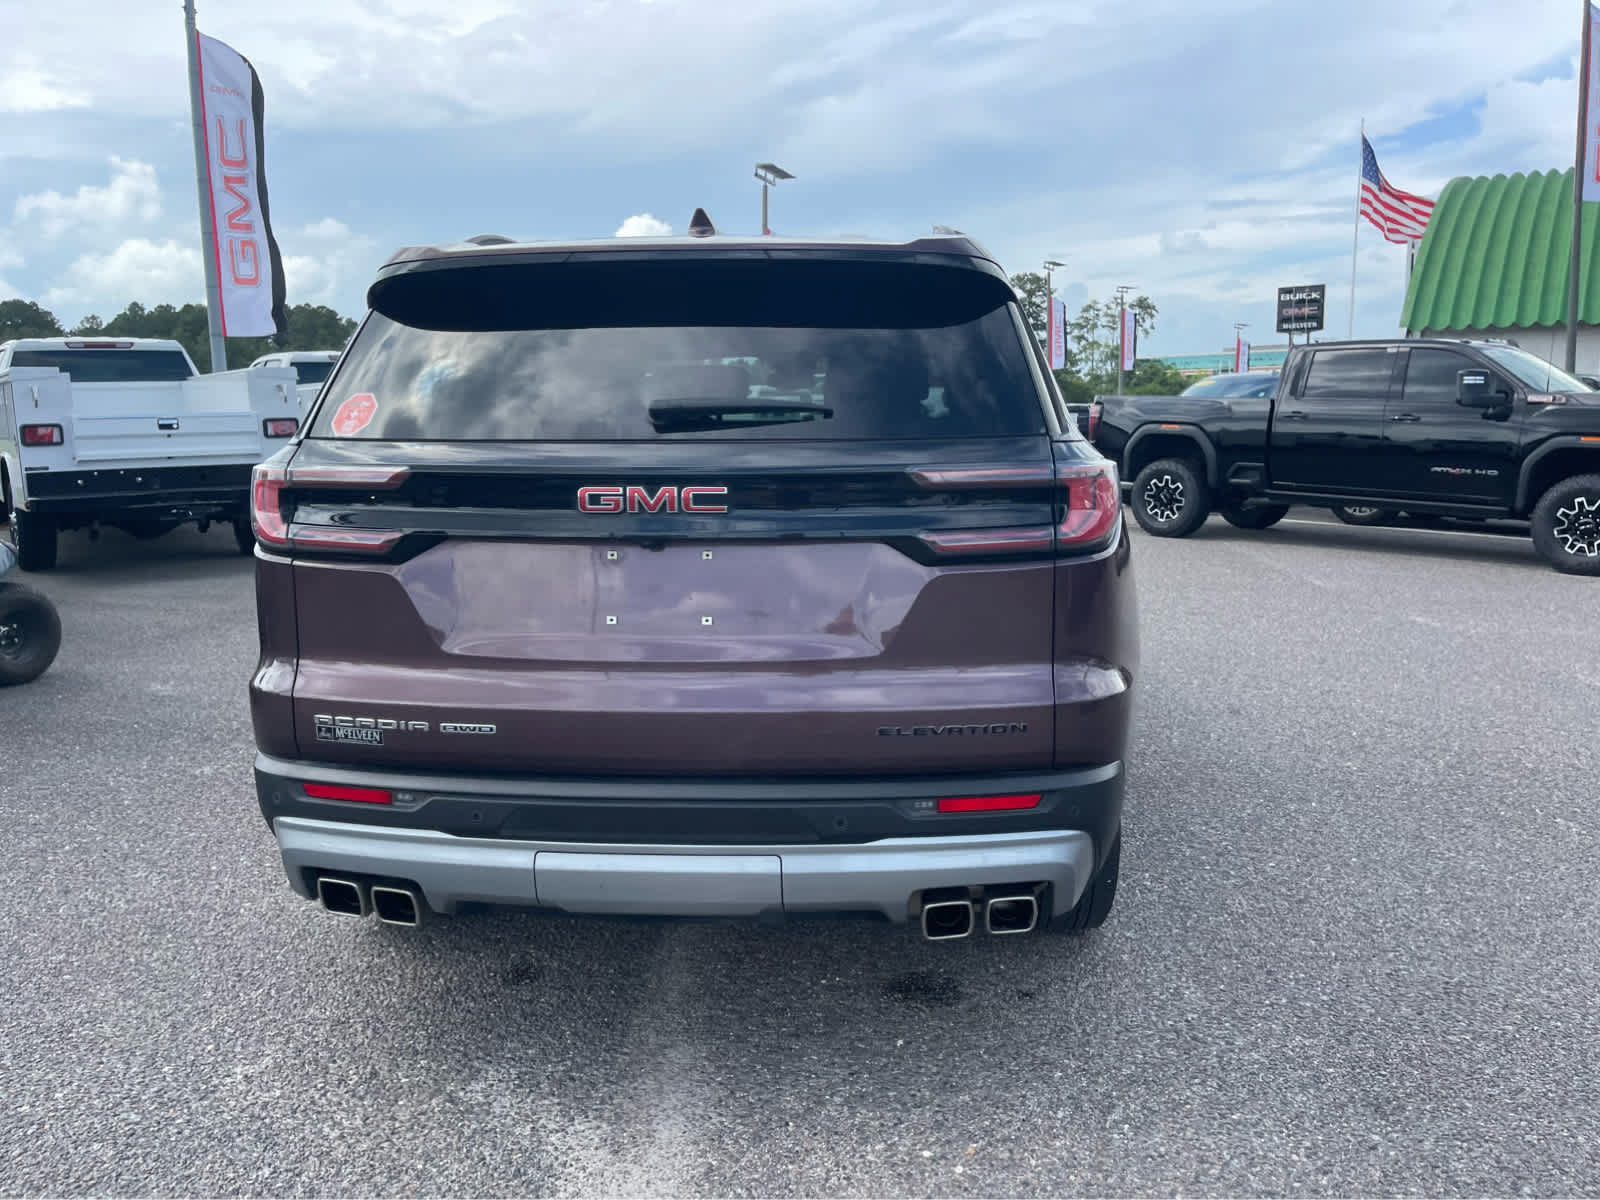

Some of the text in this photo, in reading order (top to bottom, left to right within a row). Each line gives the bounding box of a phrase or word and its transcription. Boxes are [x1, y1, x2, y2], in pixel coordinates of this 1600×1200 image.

[217, 117, 260, 287] GMC
[1280, 292, 1320, 301] BUICK
[1282, 306, 1318, 316] GMC
[577, 486, 729, 514] GMC
[313, 714, 497, 734] ACADIA AWD
[877, 723, 1029, 737] ELEVATION
